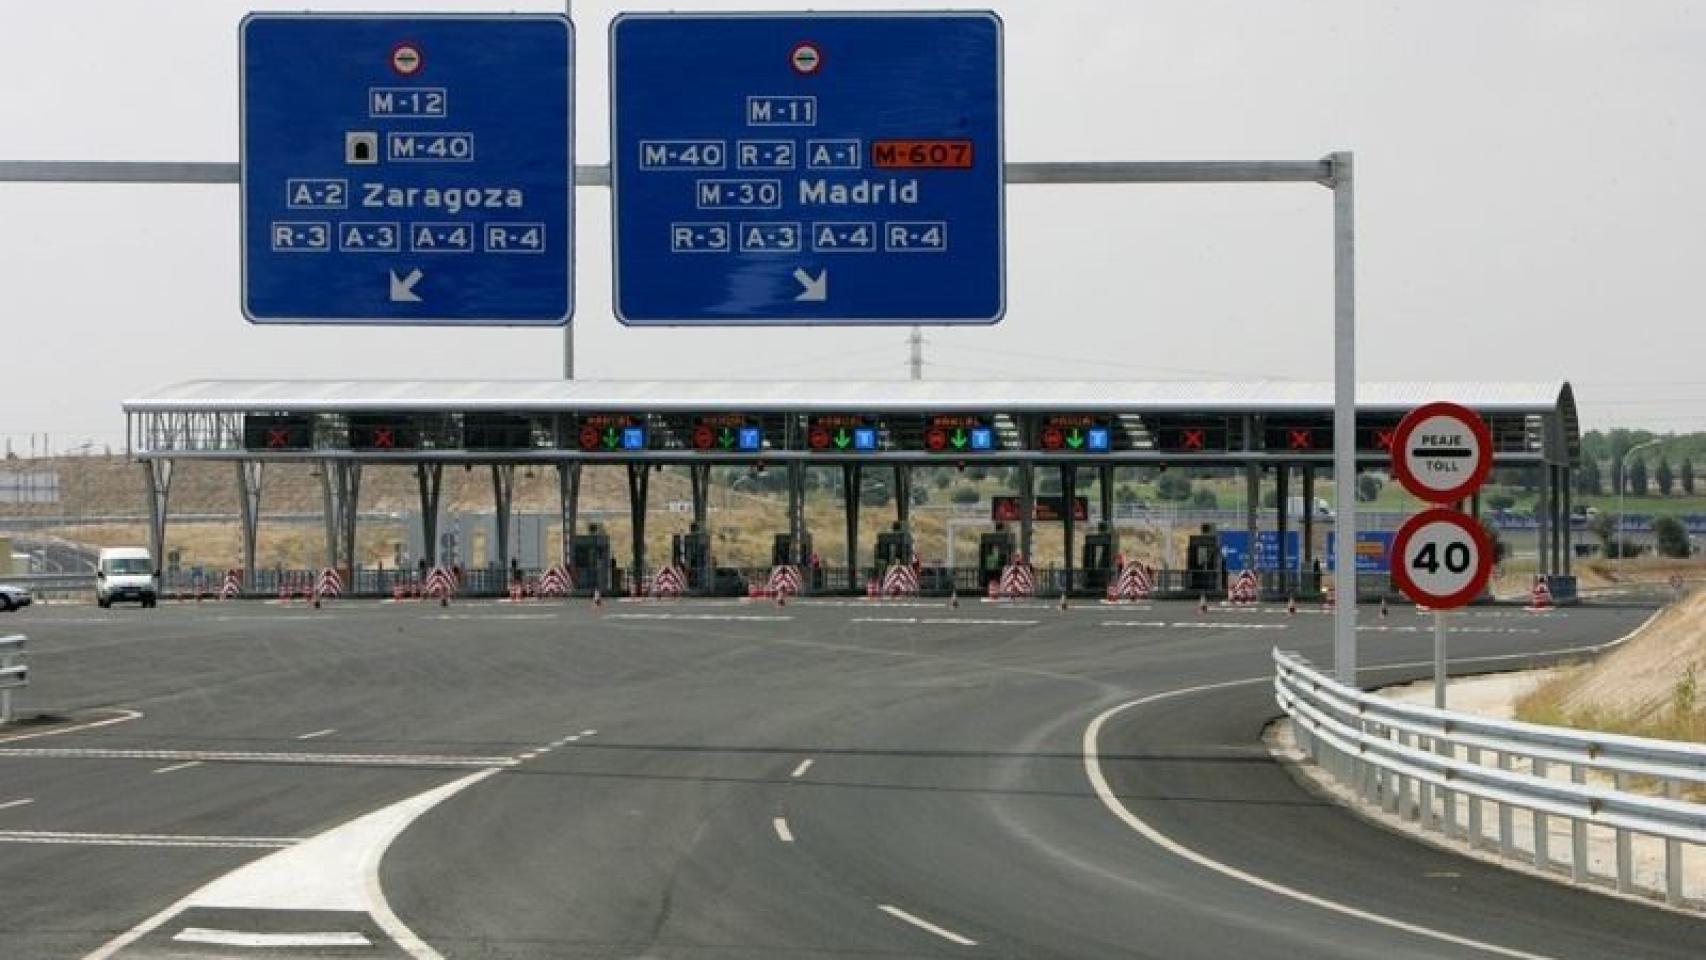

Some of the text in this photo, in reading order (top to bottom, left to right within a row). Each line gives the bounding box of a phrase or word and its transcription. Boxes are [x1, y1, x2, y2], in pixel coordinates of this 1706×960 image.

[373, 93, 443, 112] M-12
[751, 102, 813, 121] M-11
[393, 137, 469, 157] M-40
[644, 144, 968, 165] M-40 R-2 A-1 M-607
[294, 183, 524, 213] A-2 Zaragoza
[701, 179, 918, 205] M-30 Madrid
[276, 227, 541, 248] R-3 A-3 A-4 R-4
[675, 228, 941, 247] R-3 A-3 A-4 R-4
[1422, 435, 1461, 446] PEAJE
[1426, 461, 1458, 472] TOLL
[1412, 542, 1470, 574] 40
